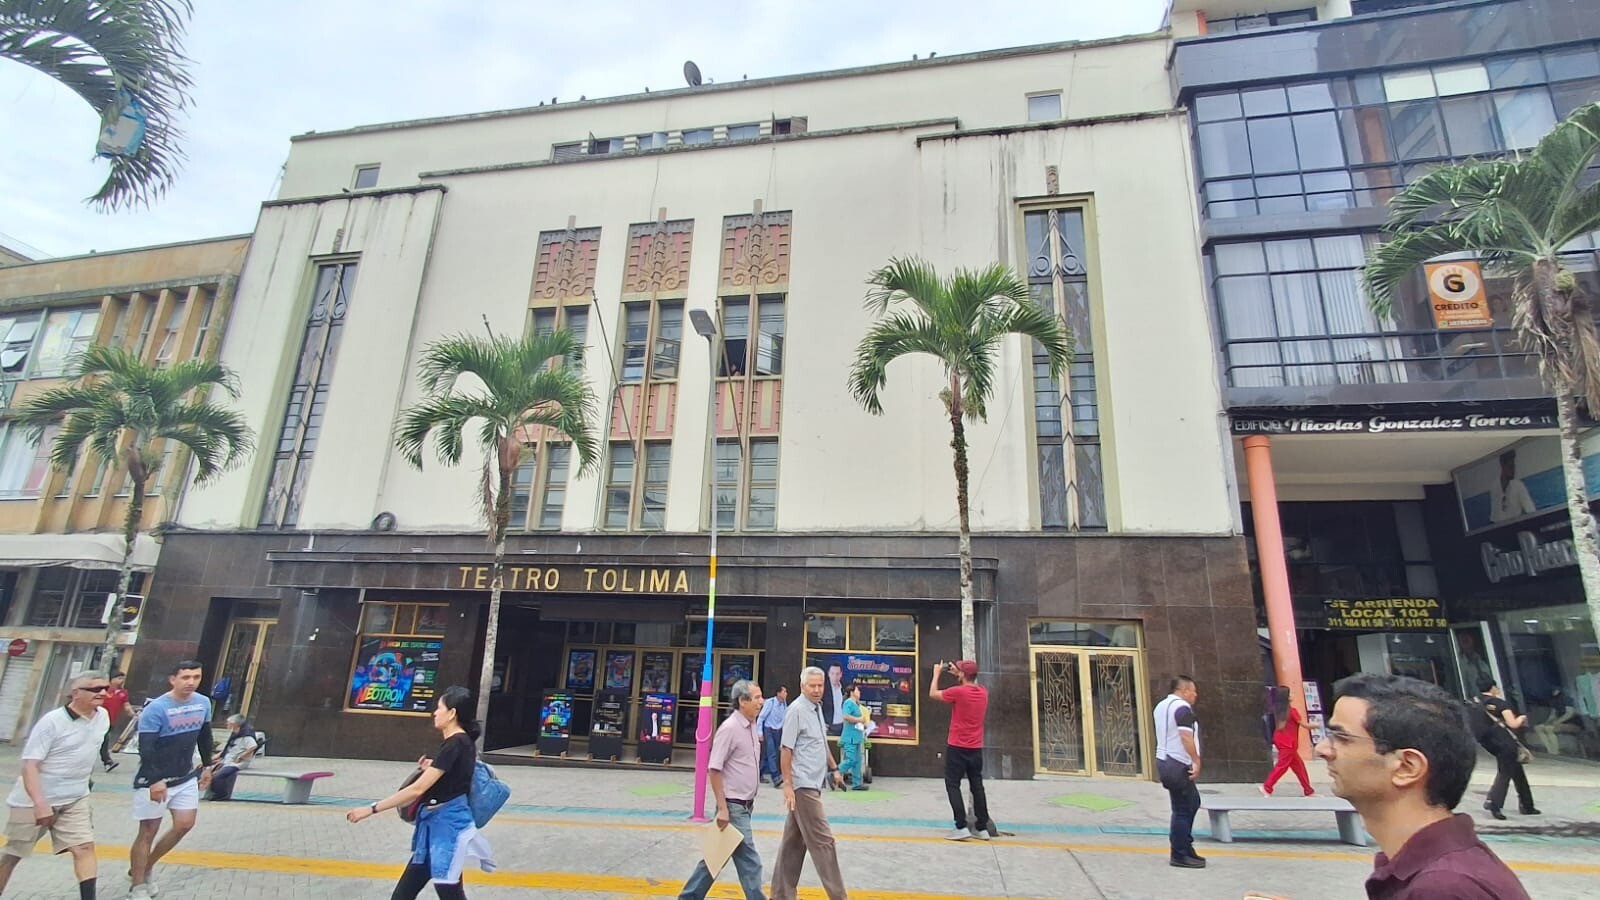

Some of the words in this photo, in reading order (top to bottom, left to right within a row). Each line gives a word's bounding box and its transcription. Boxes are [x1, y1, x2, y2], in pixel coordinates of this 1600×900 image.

[1434, 302, 1479, 311] CREDITO
[1234, 419, 1281, 431] EDIFICIO
[1284, 417, 1363, 432] Nicolas
[1368, 415, 1464, 433] Gonzalez
[1465, 414, 1531, 428] Torres
[584, 567, 690, 593] TOLIMA
[1329, 599, 1350, 608] SE
[1354, 598, 1439, 608] ARRIENDA
[1341, 608, 1395, 618] LOCAL
[1399, 608, 1429, 618] 104
